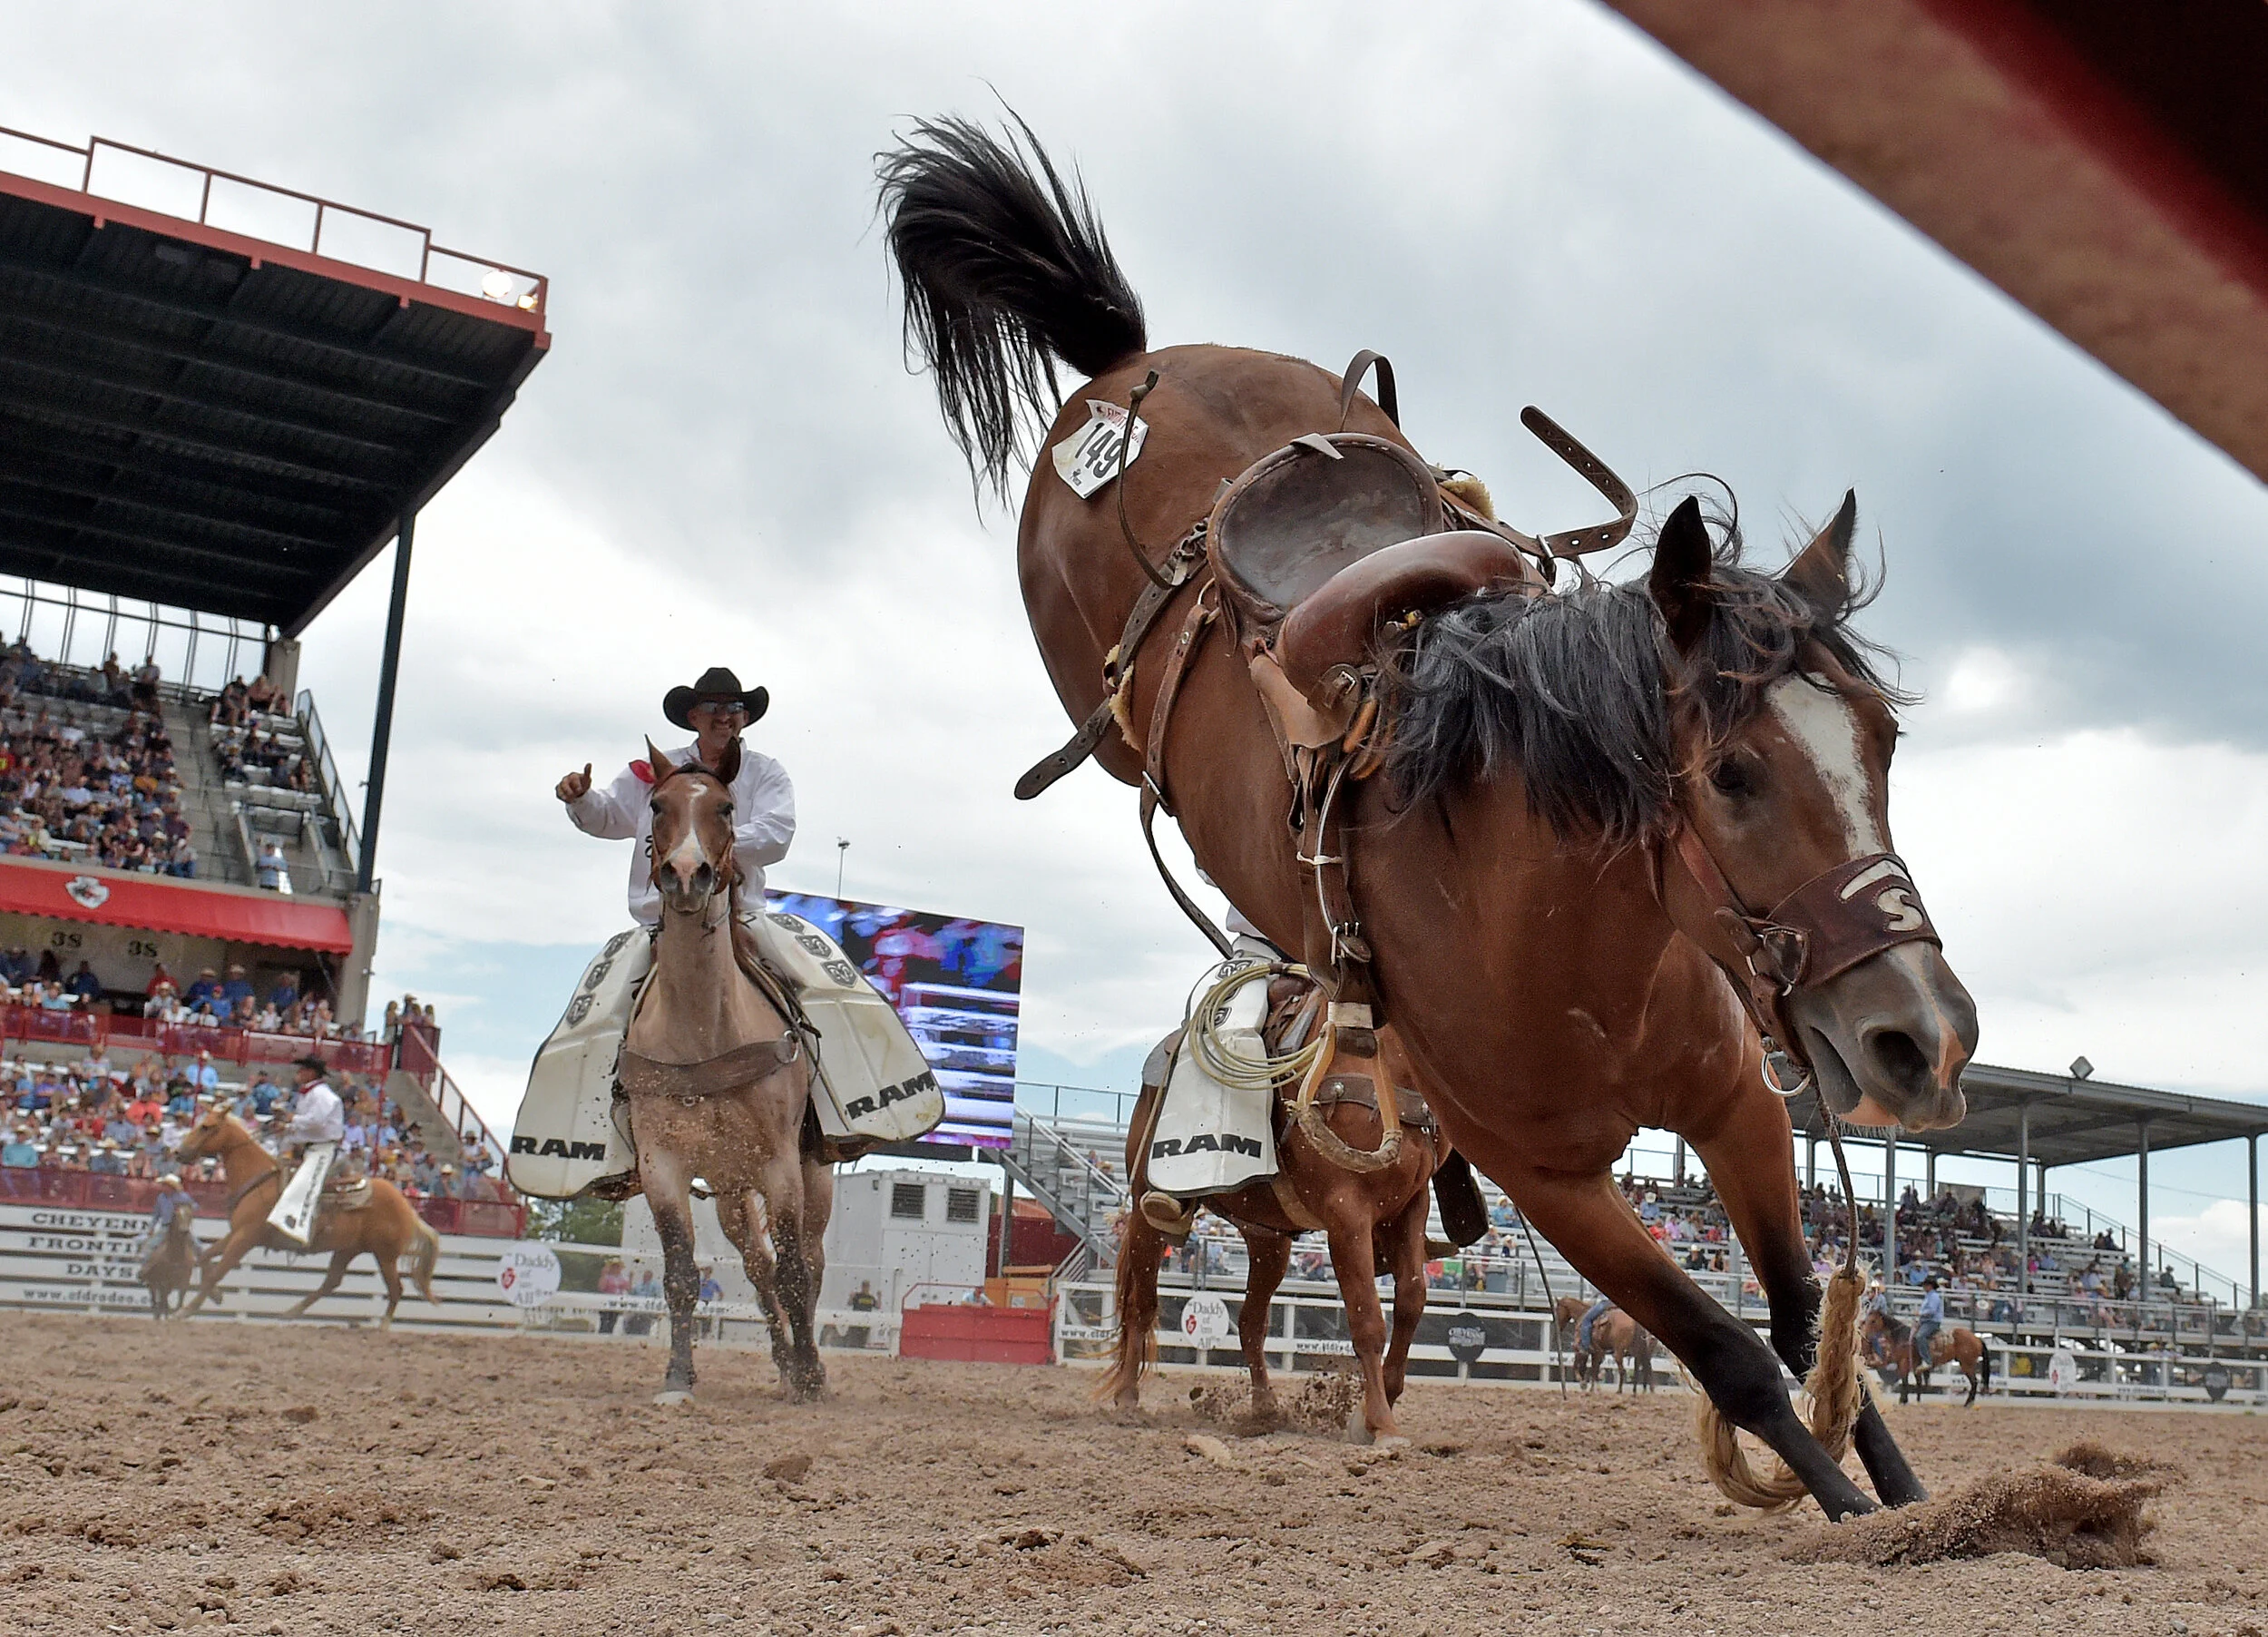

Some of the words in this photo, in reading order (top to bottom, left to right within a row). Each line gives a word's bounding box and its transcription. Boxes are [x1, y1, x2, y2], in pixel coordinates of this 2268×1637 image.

[1074, 422, 1125, 479] 149
[846, 1071, 935, 1121] RAM
[511, 1135, 606, 1162] RAM
[1151, 1134, 1262, 1160] RAM
[33, 1213, 151, 1230] CHEYENN
[28, 1237, 143, 1253] FRONTI
[66, 1263, 132, 1278] DAYS
